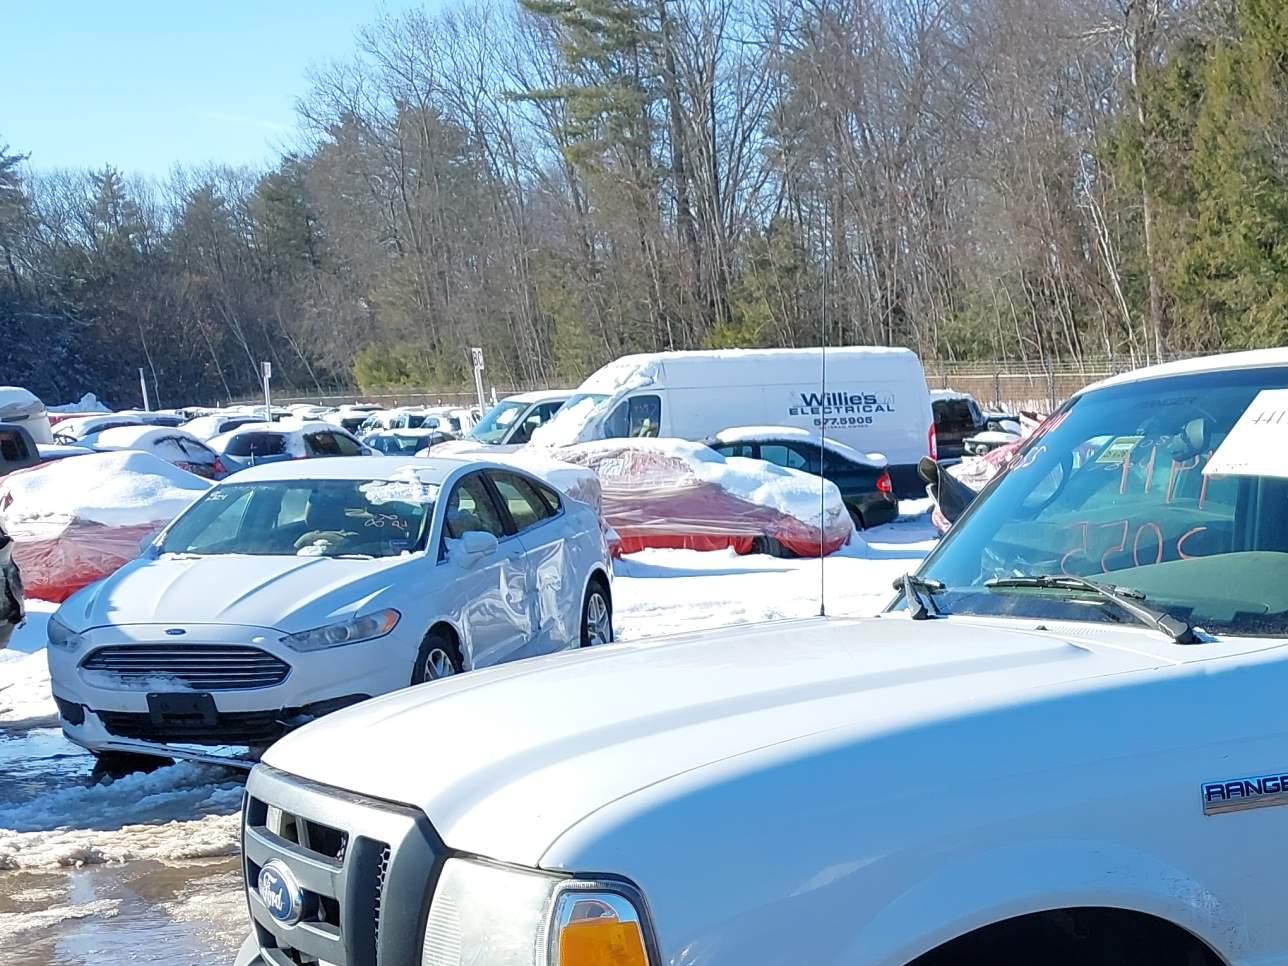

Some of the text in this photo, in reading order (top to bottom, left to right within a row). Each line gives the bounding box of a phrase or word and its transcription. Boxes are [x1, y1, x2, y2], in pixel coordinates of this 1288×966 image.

[801, 393, 876, 406] Willie's
[789, 405, 894, 415] ELECTRICAL
[261, 872, 284, 910] Ford
